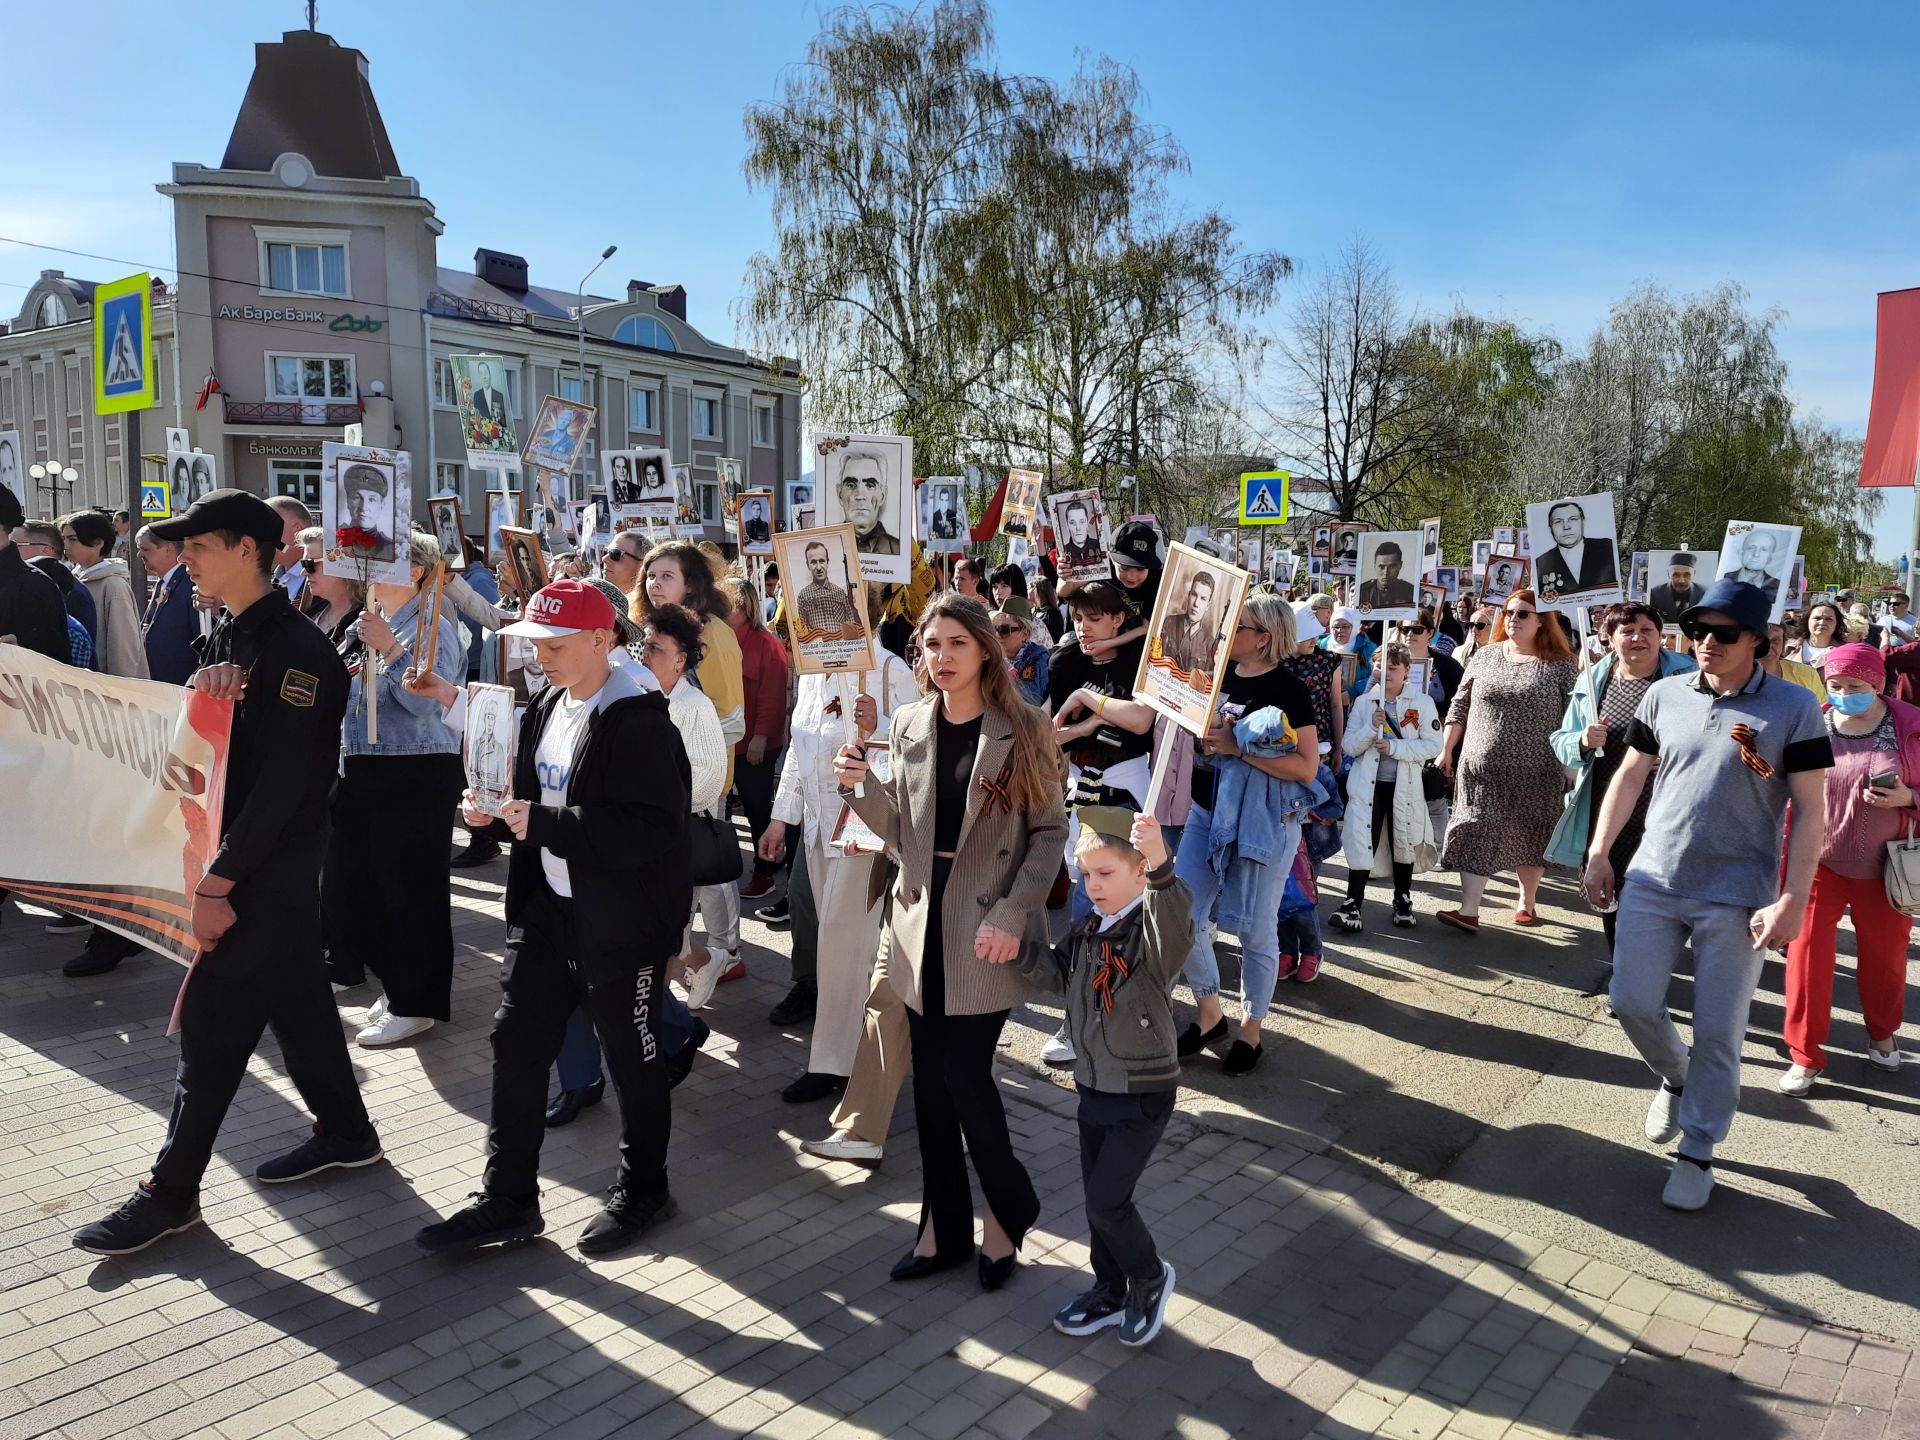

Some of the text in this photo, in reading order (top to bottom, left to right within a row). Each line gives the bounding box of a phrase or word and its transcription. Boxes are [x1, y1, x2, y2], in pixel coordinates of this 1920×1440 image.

[219, 304, 324, 324] Ак Барс Банк
[249, 441, 315, 456] Банкомат
